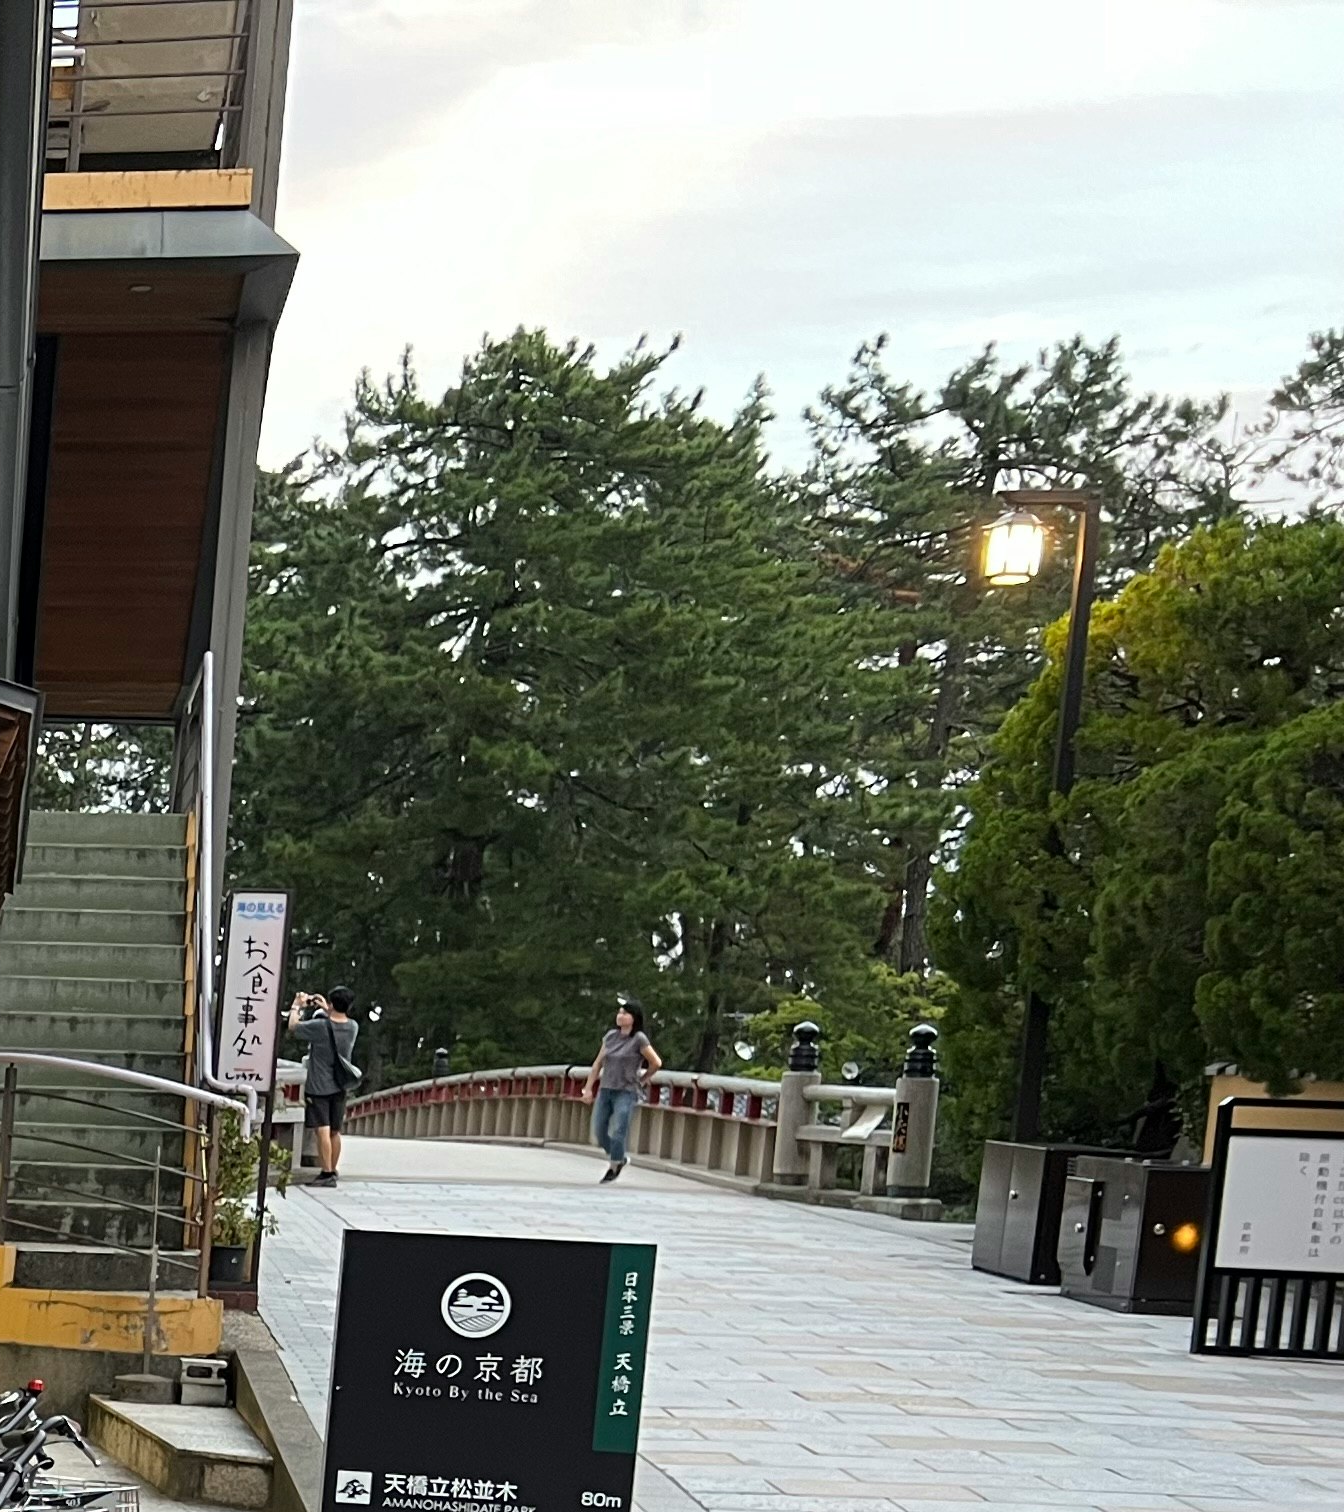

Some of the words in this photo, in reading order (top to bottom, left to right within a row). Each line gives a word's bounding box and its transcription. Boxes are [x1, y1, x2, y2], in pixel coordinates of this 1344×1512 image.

[233, 935, 275, 1057] お食事処
[618, 1271, 639, 1337] 日本三景
[393, 1349, 544, 1386] 海の京都
[609, 1352, 633, 1416] 天橋立
[393, 1382, 441, 1398] Kyoto
[449, 1386, 469, 1401] By
[477, 1387, 503, 1402] the
[511, 1389, 538, 1403] Sea
[383, 1473, 518, 1501] 天橋立松並木
[581, 1491, 622, 1508] 80m
